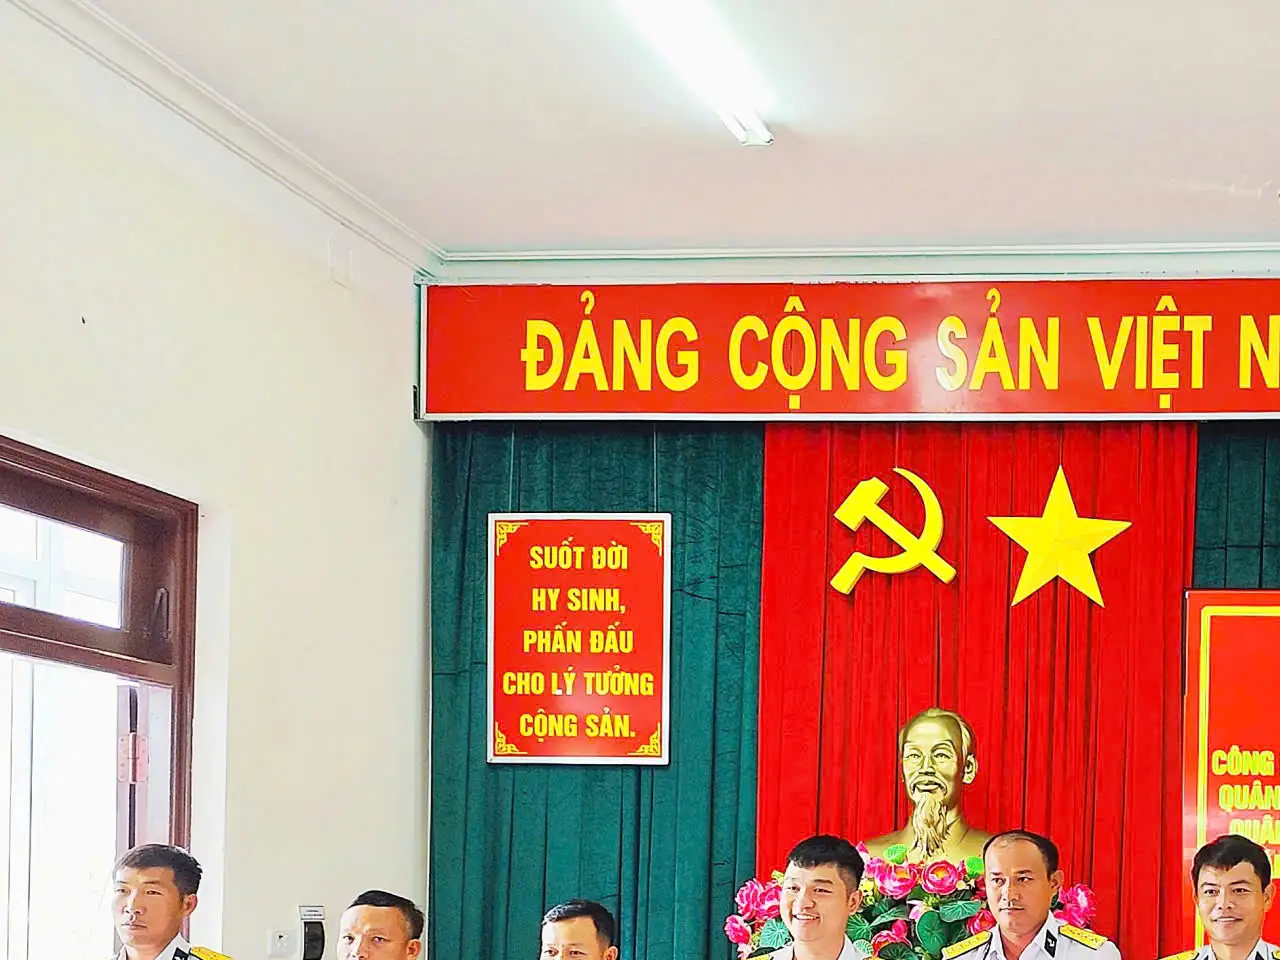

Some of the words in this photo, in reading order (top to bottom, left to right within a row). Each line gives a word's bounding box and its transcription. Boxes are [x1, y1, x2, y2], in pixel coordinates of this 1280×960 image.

[521, 291, 700, 392] ĐẢNG
[728, 295, 909, 409] CỘNG
[935, 287, 1060, 391] SẢN
[1087, 294, 1212, 409] VIỆT
[530, 537, 585, 569] SUỐT
[592, 540, 628, 570] ĐỜI
[532, 588, 560, 611] HY
[568, 588, 626, 614] SINH,
[523, 621, 582, 653] PHẤN
[590, 621, 633, 653] ĐẤU
[502, 671, 544, 695] CHO
[552, 666, 576, 696] LÝ
[584, 664, 654, 696] TƯỞNG
[519, 708, 577, 742] CỘNG
[585, 706, 636, 738] SẢN.
[1211, 745, 1274, 776] CÔNG
[1218, 780, 1280, 813] QUÂN
